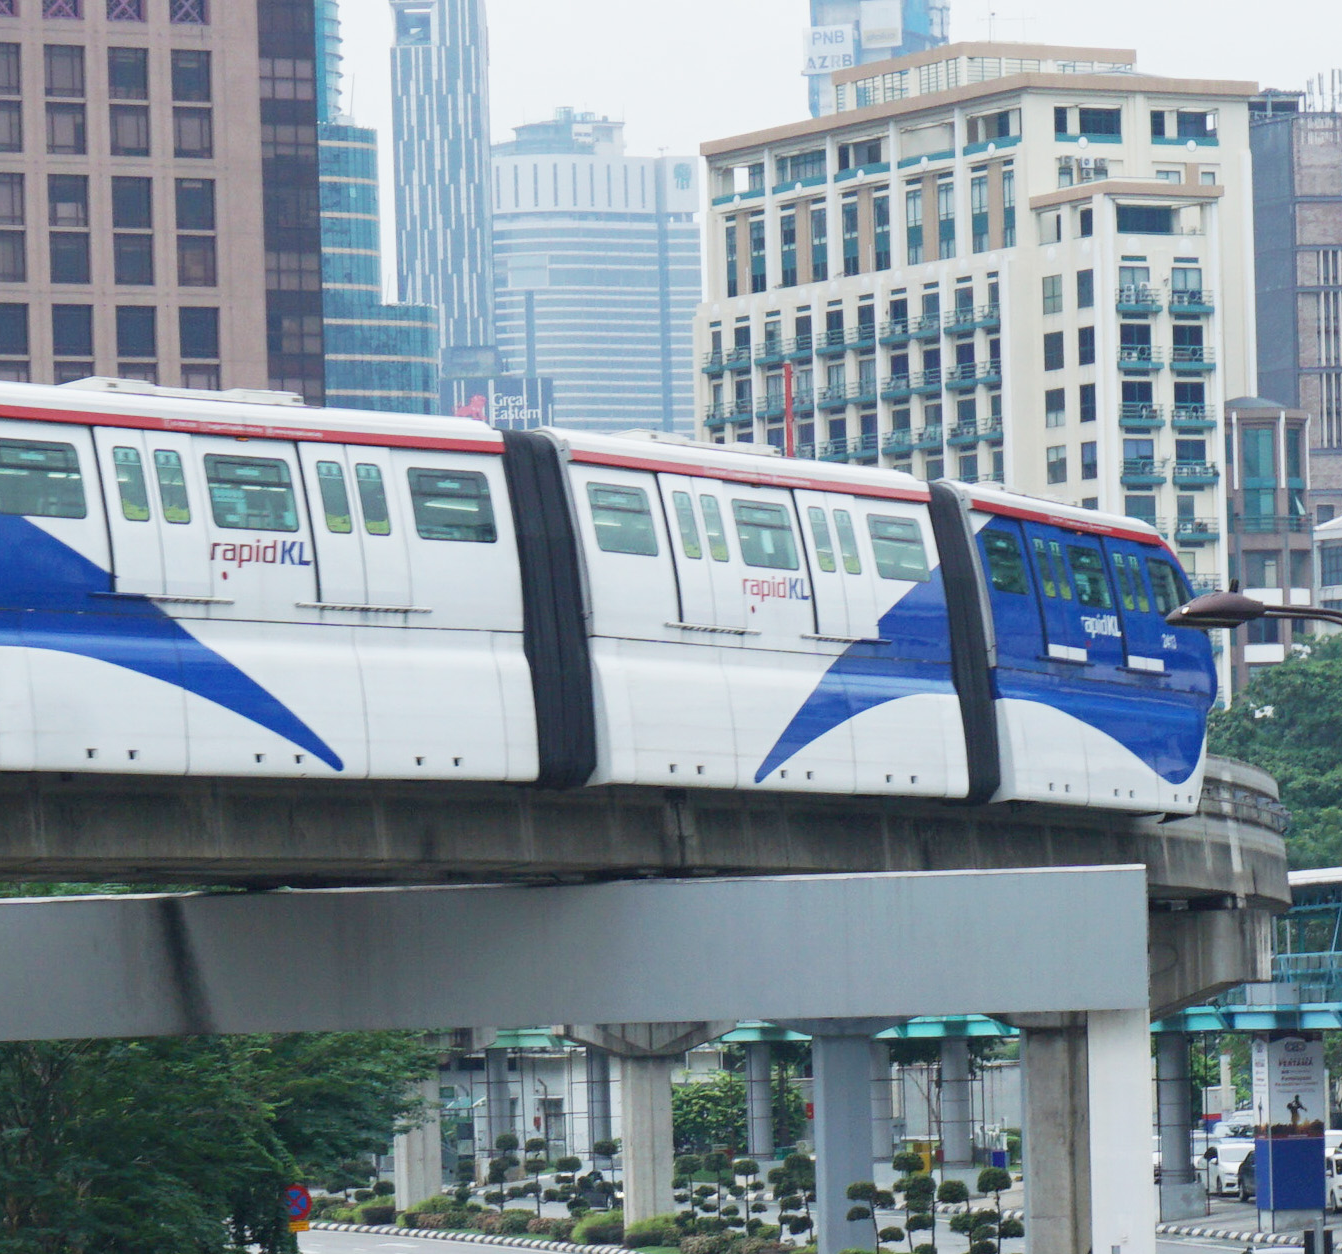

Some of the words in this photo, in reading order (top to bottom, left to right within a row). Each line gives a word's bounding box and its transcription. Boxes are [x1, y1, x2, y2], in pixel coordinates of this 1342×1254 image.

[812, 30, 844, 45] PNB
[210, 538, 312, 568] rapidKL
[743, 575, 811, 602] rapidKL
[1080, 613, 1122, 638] rapidKL
